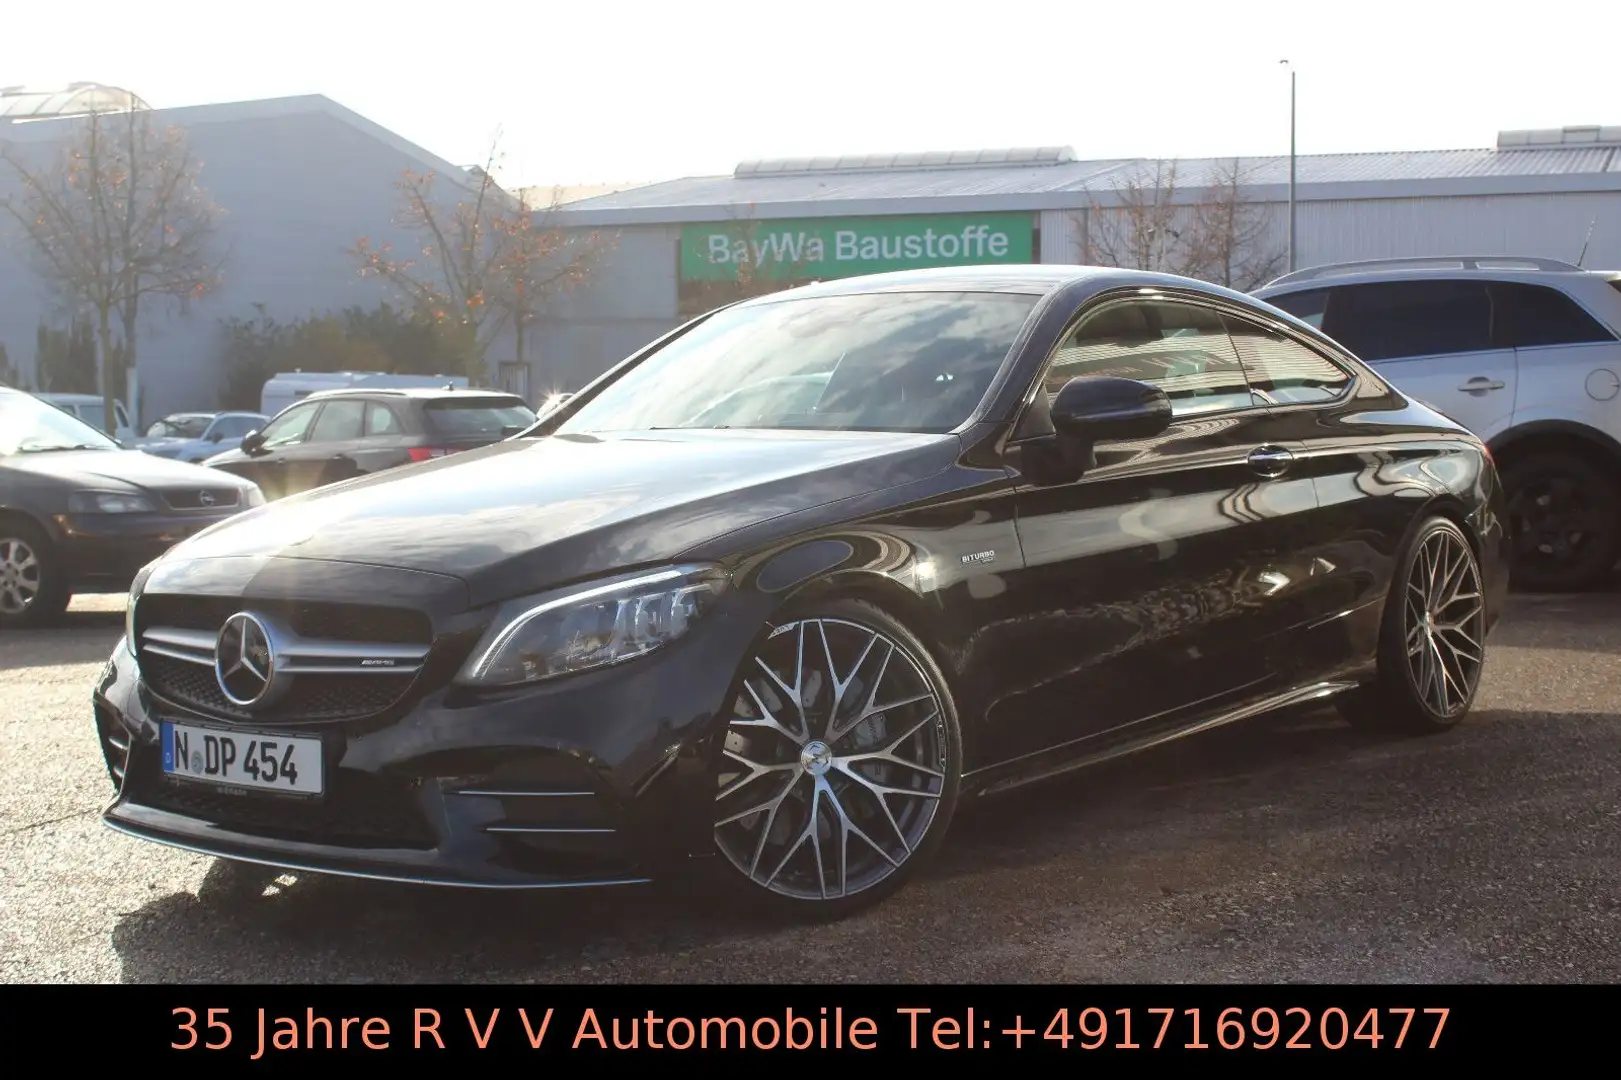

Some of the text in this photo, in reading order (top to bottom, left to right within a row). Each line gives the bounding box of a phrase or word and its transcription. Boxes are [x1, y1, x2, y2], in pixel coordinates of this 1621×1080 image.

[708, 224, 1009, 266] BayWa Baustoffe
[961, 549, 995, 563] BITURBO
[174, 730, 298, 785] N DP 454
